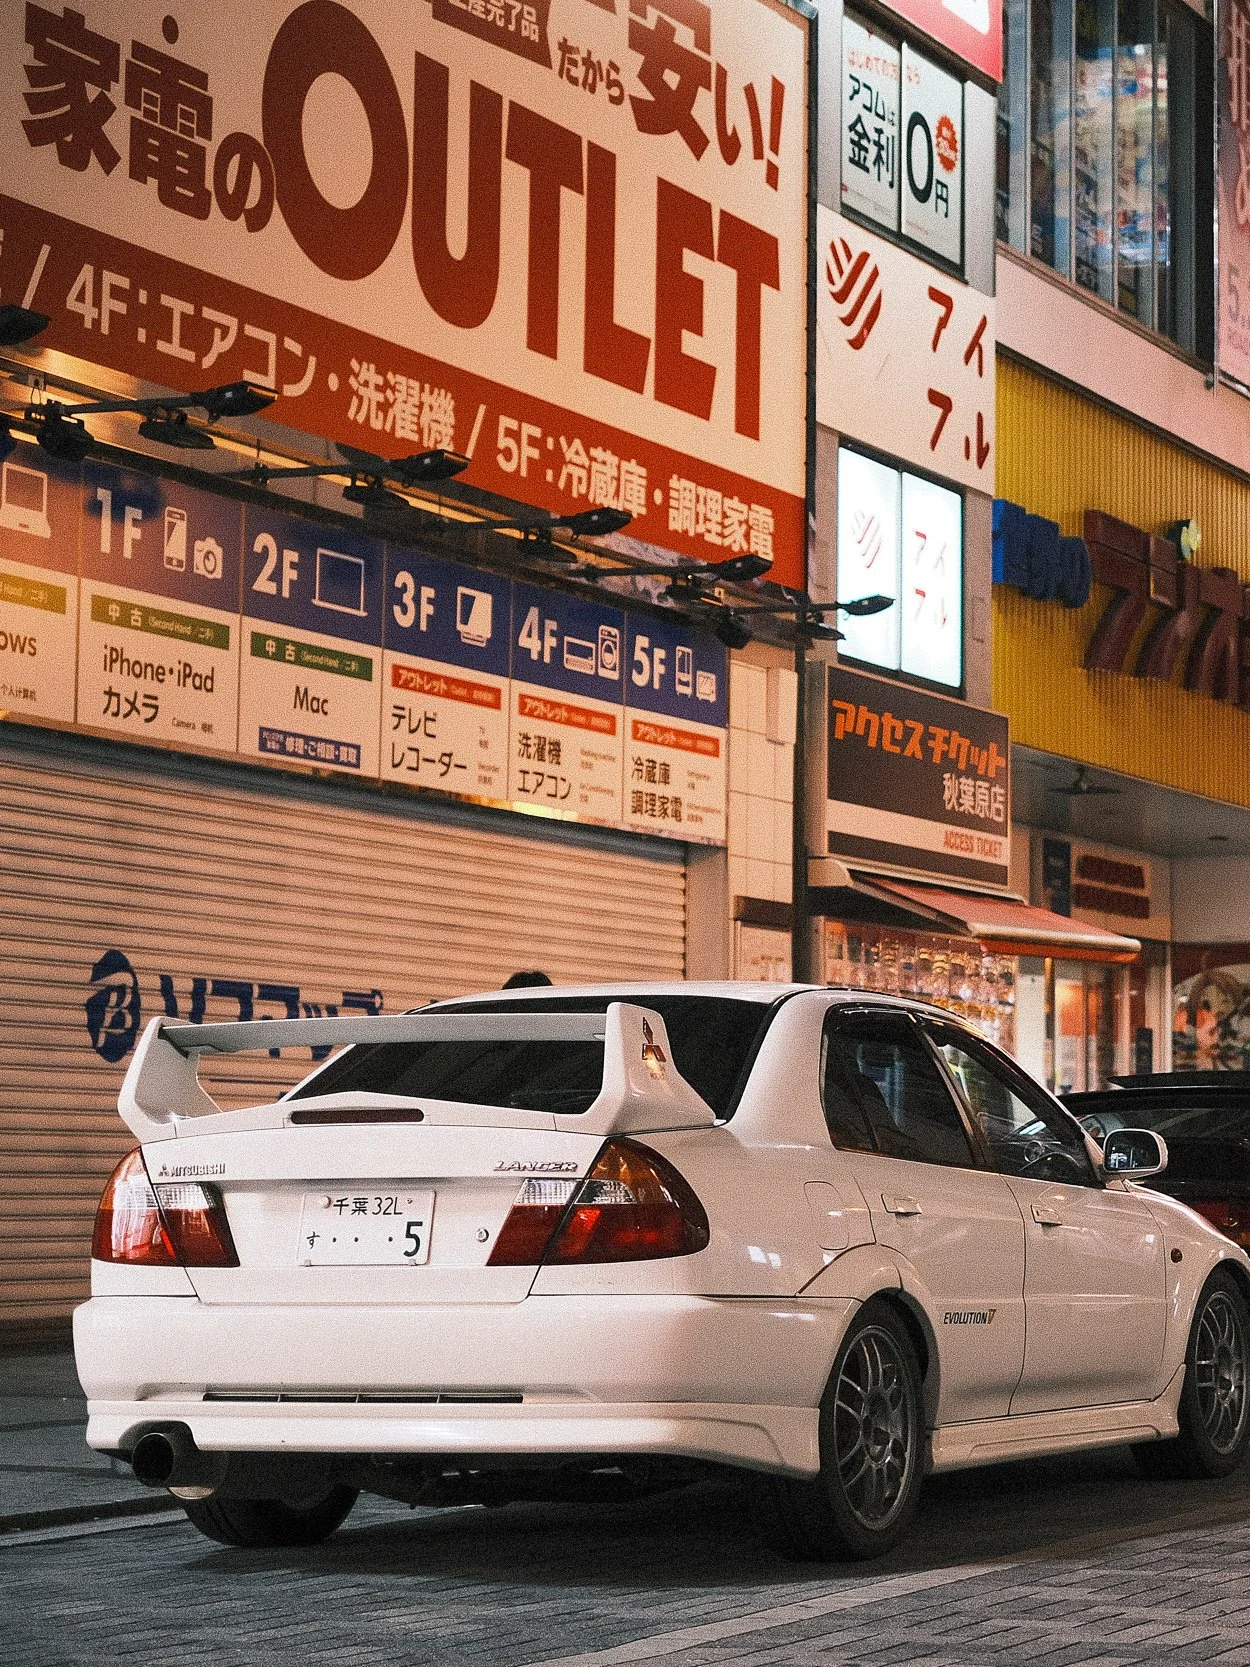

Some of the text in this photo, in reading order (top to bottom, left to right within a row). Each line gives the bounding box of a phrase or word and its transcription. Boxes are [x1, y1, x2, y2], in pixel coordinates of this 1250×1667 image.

[847, 113, 895, 190] 金利
[262, 0, 781, 442] OUTLET
[96, 487, 143, 560] 1F
[252, 532, 300, 599] 2F
[393, 570, 436, 632] 3F
[518, 607, 557, 664] 4F
[631, 634, 667, 690] 5F
[102, 685, 160, 723] カメラ
[293, 685, 329, 716] Mac
[392, 705, 438, 739] テレビ
[391, 742, 468, 778] レコーダー
[518, 732, 562, 766] 洗濯機
[518, 769, 572, 800] エアコン
[632, 757, 671, 786] 冷蔵庫
[631, 790, 682, 823] 調理家電
[942, 772, 1006, 823] 秋葉原店
[171, 1163, 226, 1177] MITSUBISHI
[493, 1161, 579, 1173] LANCER
[333, 1196, 369, 1216] 千葉
